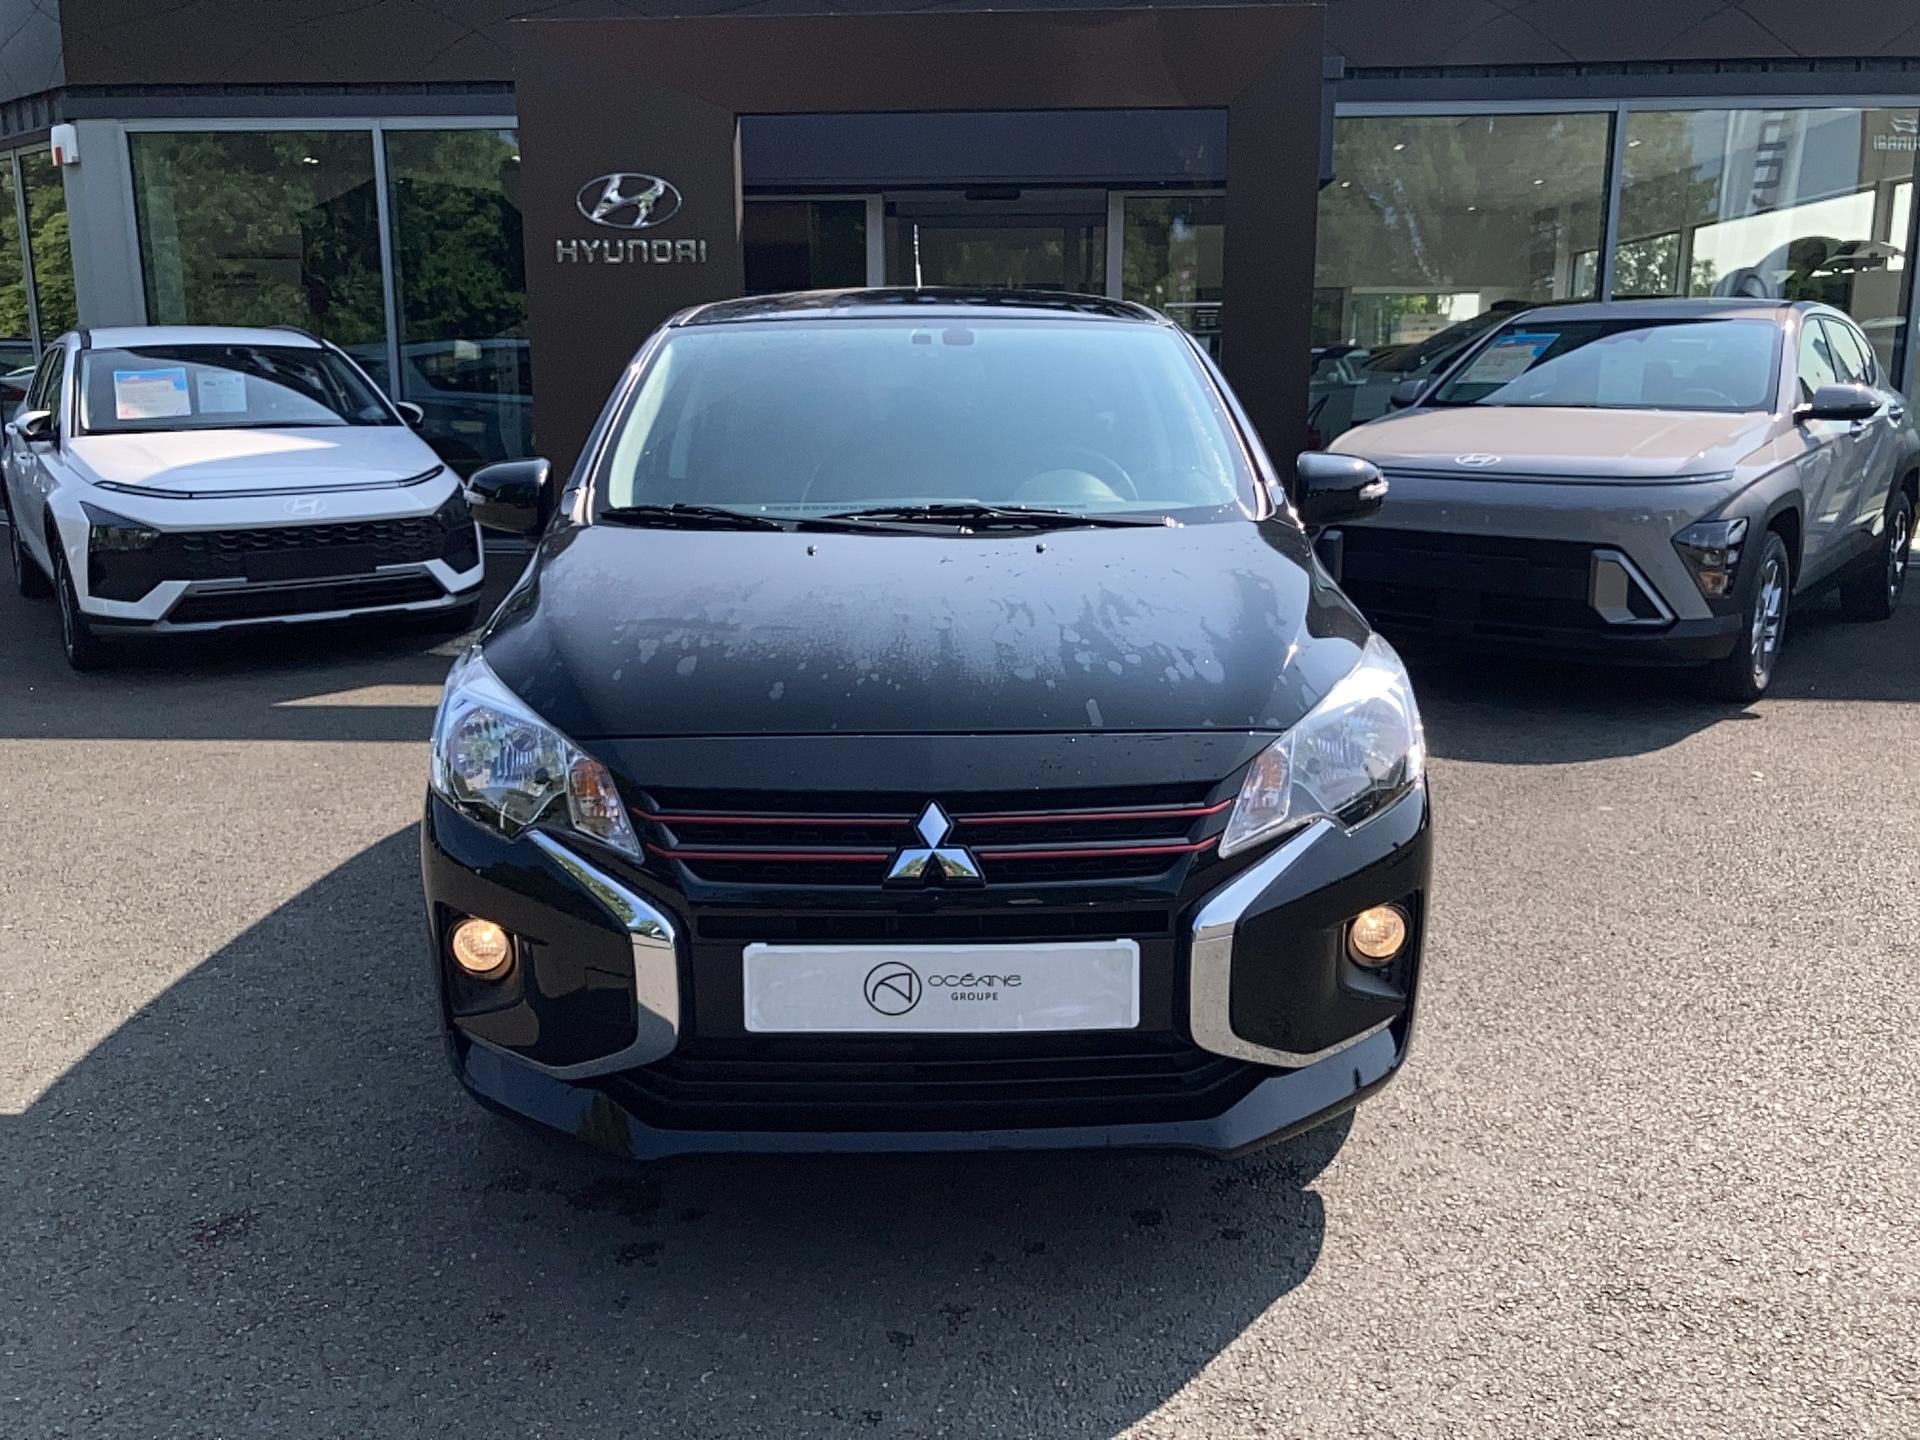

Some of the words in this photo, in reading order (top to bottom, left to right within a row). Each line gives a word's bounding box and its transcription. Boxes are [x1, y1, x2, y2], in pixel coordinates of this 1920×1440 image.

[556, 239, 706, 264] HYUNDAI
[928, 972, 1022, 987] OCÉANE
[951, 992, 998, 1001] GROUPE
